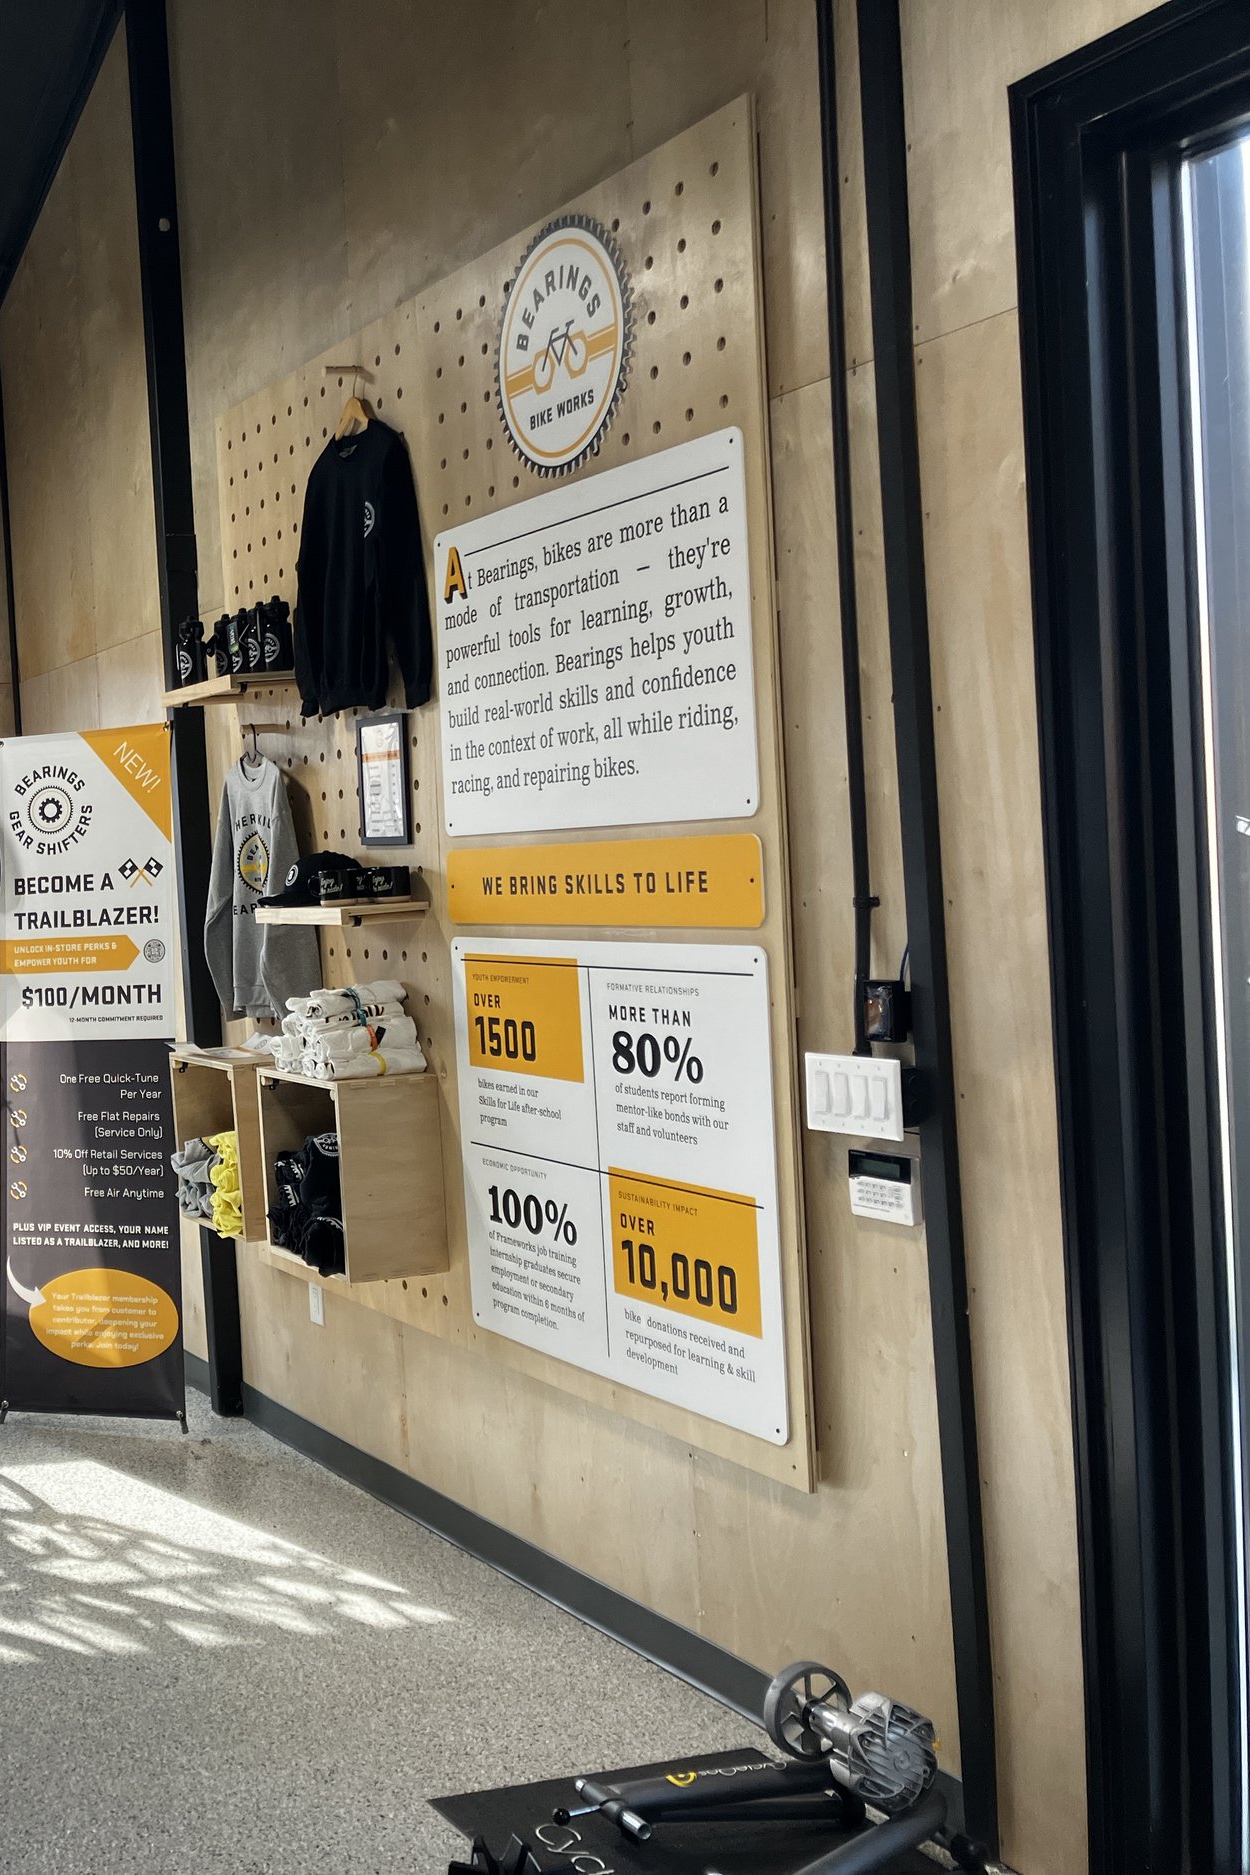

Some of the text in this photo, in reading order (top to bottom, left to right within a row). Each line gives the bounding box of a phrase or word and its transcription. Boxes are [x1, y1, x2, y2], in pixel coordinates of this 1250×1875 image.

[515, 263, 602, 352] BEARINGS
[529, 388, 595, 431] BIKE WORKS
[477, 557, 538, 588] Bearings,
[543, 541, 582, 567] bikes
[587, 532, 613, 554] are
[620, 515, 663, 545] more
[670, 501, 710, 529] than
[718, 496, 729, 514] a
[445, 538, 732, 630] mode of transportation they're
[445, 575, 733, 669] powerful tools for learning, growth,
[447, 616, 735, 696] and connection. Bearings helps youth
[449, 663, 737, 729] build real-world skills and confidence
[450, 704, 739, 762] in the context of work, all while riding,
[14, 765, 85, 796] BEARINGS
[113, 741, 161, 793] NEW!
[451, 756, 640, 797] racing, and repairing bikes.
[9, 804, 93, 856] GEAR SHIFTERS
[14, 873, 114, 896] BECOME A
[482, 870, 708, 896] WE BRING SKILLS TO LIFE
[14, 905, 159, 930] TRAILBLAZER!
[14, 945, 45, 954] UNLOCK
[44, 944, 81, 953] IN-STORE
[83, 942, 110, 951] PERKS
[14, 956, 97, 967] EMPOWER YOUTH FOR
[22, 983, 162, 1010] $100/MONTH
[474, 993, 501, 1009] OVER
[606, 982, 700, 997] FORMATIVE RELATIONSHIPS
[97, 1015, 135, 1023] COMMITMENT
[609, 1004, 691, 1027] MORE THAN
[475, 1015, 537, 1062] 1500
[612, 1030, 704, 1084] 80%
[59, 1073, 159, 1084] One Free Quick-Tune
[478, 1078, 539, 1098] bikes earned in our
[120, 1089, 162, 1099] Per Year
[478, 1095, 562, 1120] Skills for Life after-school
[615, 1083, 726, 1112] of students report forming
[78, 1111, 160, 1123] Free Flat Repairs
[480, 1114, 508, 1127] program
[616, 1102, 729, 1130] mentor-like bonds with our
[94, 1126, 163, 1140] (Service Only)
[617, 1122, 698, 1146] staff and volunteers
[53, 1149, 163, 1160] 10% Off Retail Services
[83, 1164, 164, 1177] (Up to $50/Year)
[482, 1158, 547, 1180] ECONOMIC OPPORTUNITY
[84, 1187, 164, 1201] Free Air Anytime
[618, 1190, 699, 1217] SUSTAINABILITY IMPACT
[13, 1223, 169, 1235] PLUS VIP EVENT ACCESS, YOUR NAME
[488, 1185, 578, 1247] 100%
[620, 1212, 655, 1236] OVER
[13, 1236, 169, 1249] LISTED AS A TRAILBLAZER, AND MORE!
[488, 1230, 577, 1268] of Frameworks job training
[490, 1246, 581, 1285] internship graduates secure
[621, 1239, 738, 1315] 10,000
[624, 1308, 745, 1359] bike donations received and
[625, 1330, 756, 1383] repurposed for learning & skill
[626, 1348, 679, 1375] development
